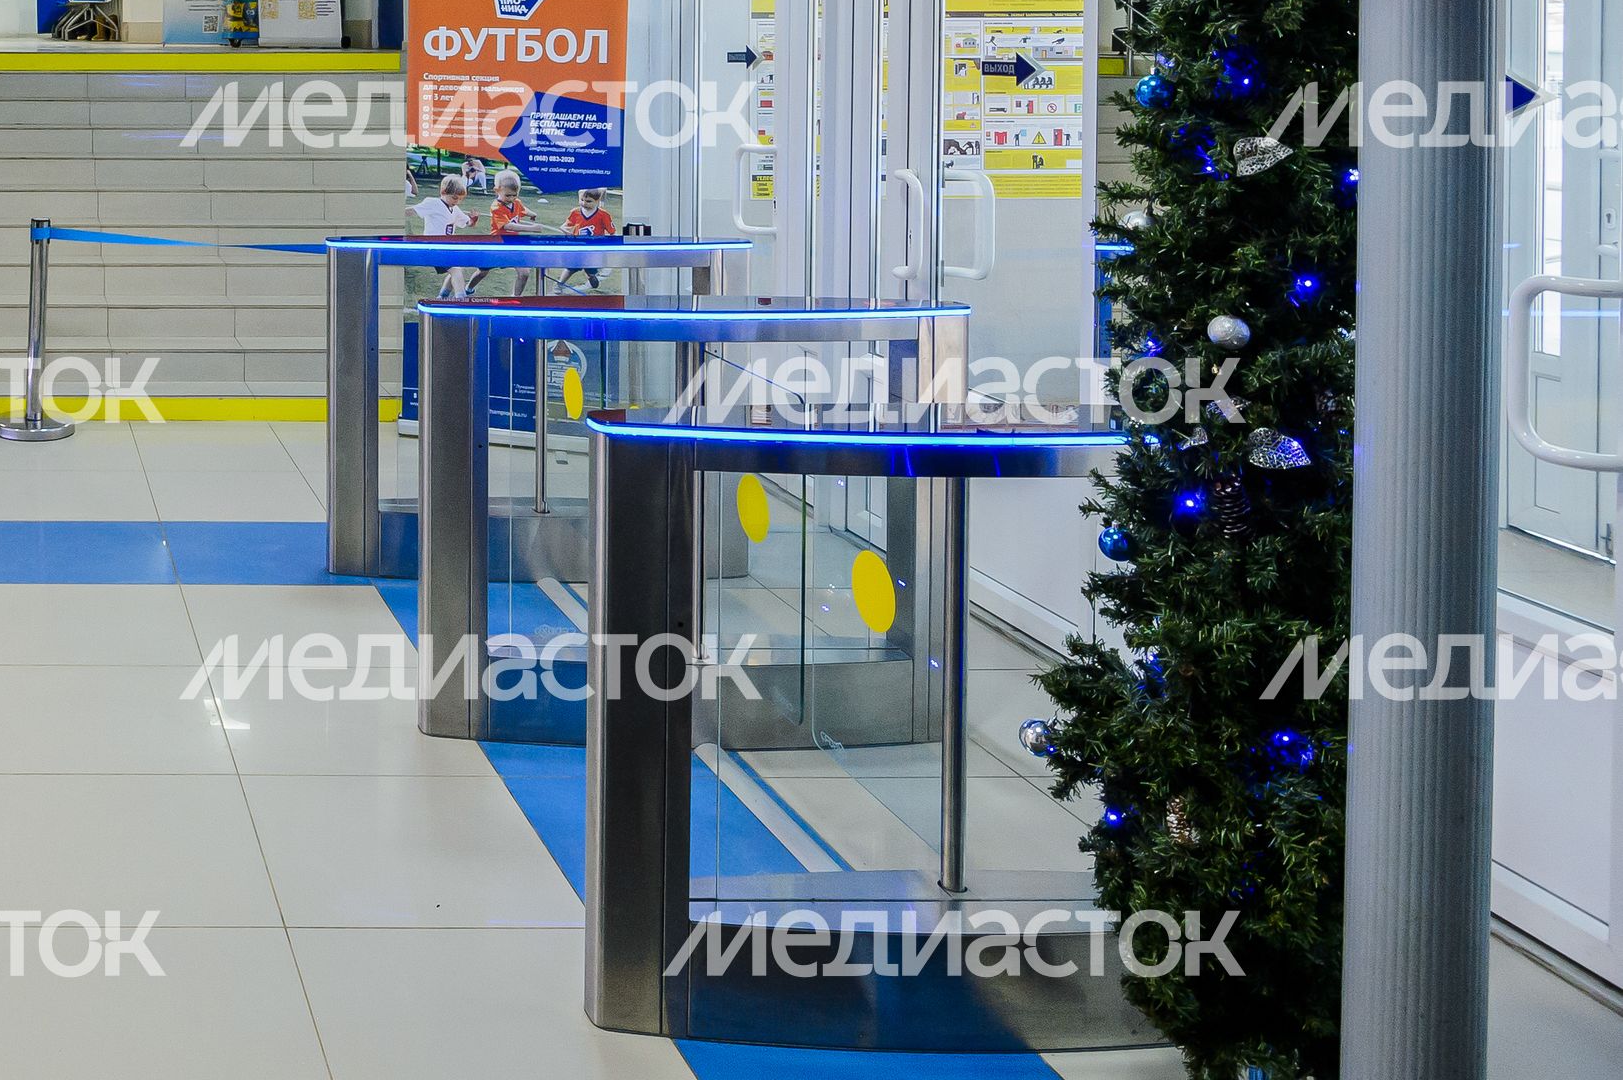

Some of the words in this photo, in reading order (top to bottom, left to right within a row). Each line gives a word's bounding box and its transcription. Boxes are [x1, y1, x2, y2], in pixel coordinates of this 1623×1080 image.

[500, 4, 528, 14] НИКА
[423, 26, 608, 64] ФУТБОЛ
[984, 64, 1015, 74] ВЫХОД
[423, 73, 470, 82] Спортивная
[423, 84, 438, 92] для
[530, 112, 584, 121] ПРИГЛАШАЕМ
[530, 120, 580, 128] БЕСПЛАТНОЕ
[581, 122, 612, 130] ПЕРВОЕ
[530, 128, 565, 136] ЗАНЯТИЕ
